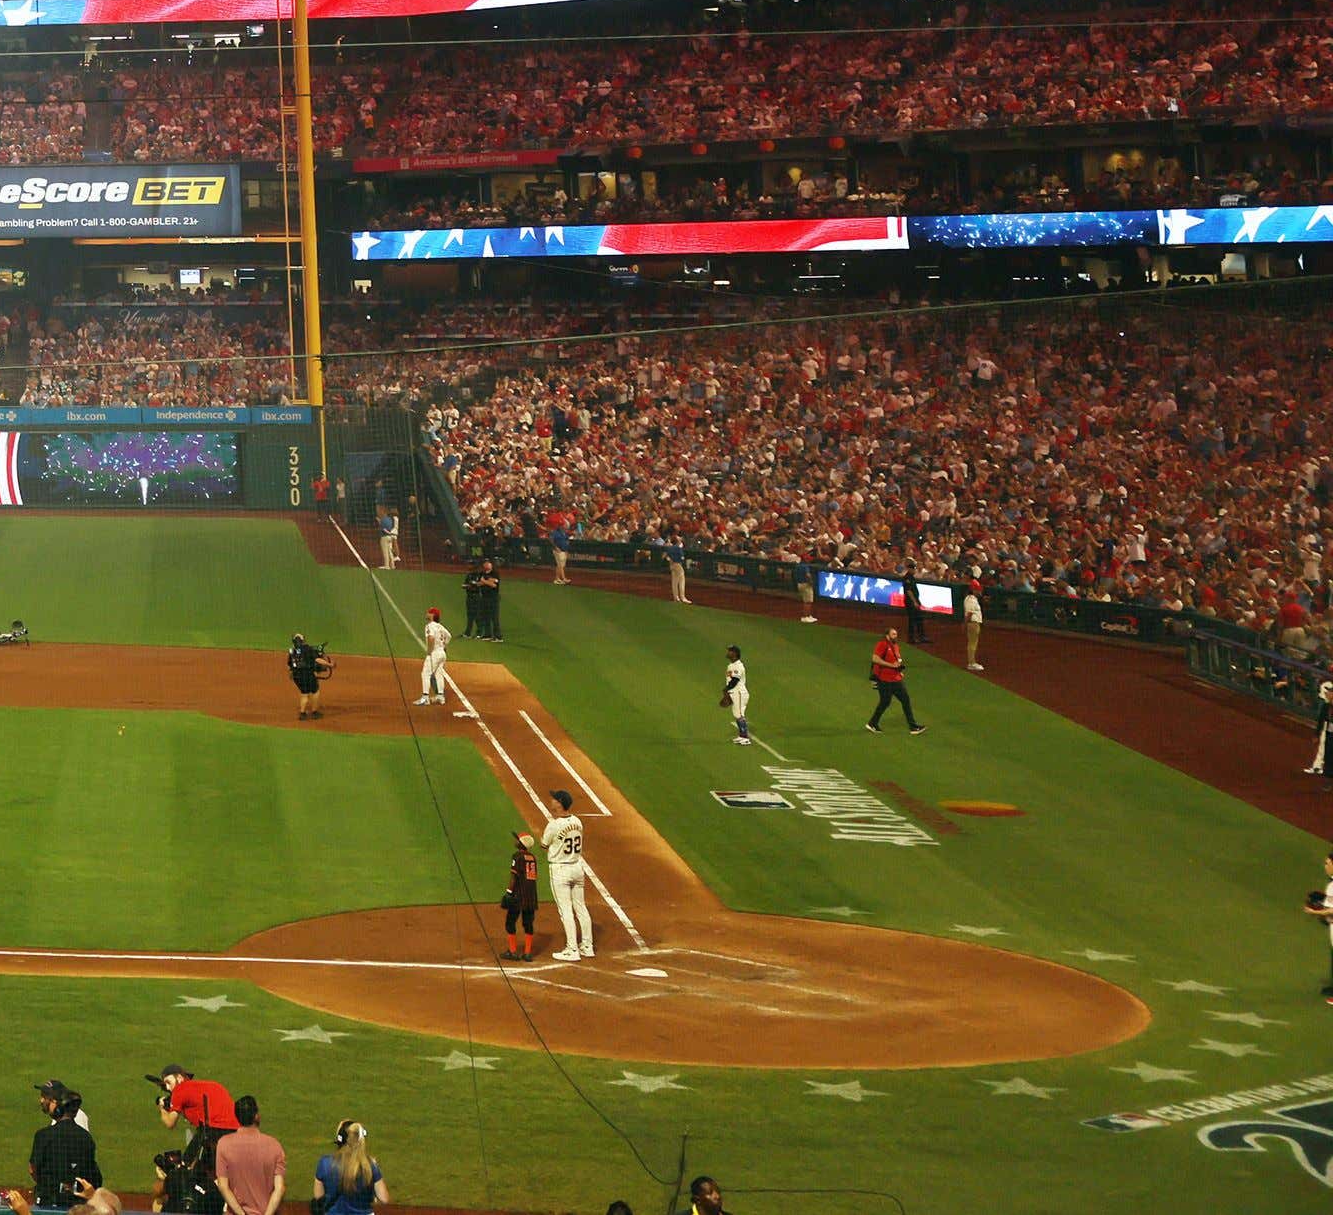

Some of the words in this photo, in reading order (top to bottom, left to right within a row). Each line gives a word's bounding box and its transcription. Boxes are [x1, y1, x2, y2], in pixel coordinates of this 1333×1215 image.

[456, 155, 478, 164] Best
[479, 153, 518, 163] Network
[139, 179, 218, 202] BET
[36, 218, 78, 227] Problem?
[80, 218, 98, 226] Call
[99, 217, 182, 227] 1-800-GAMBLER.
[184, 217, 199, 226] 21+
[67, 410, 106, 421] ibx.com
[156, 410, 225, 421] Independence
[262, 410, 301, 421] ibx.com
[564, 836, 581, 854] 32
